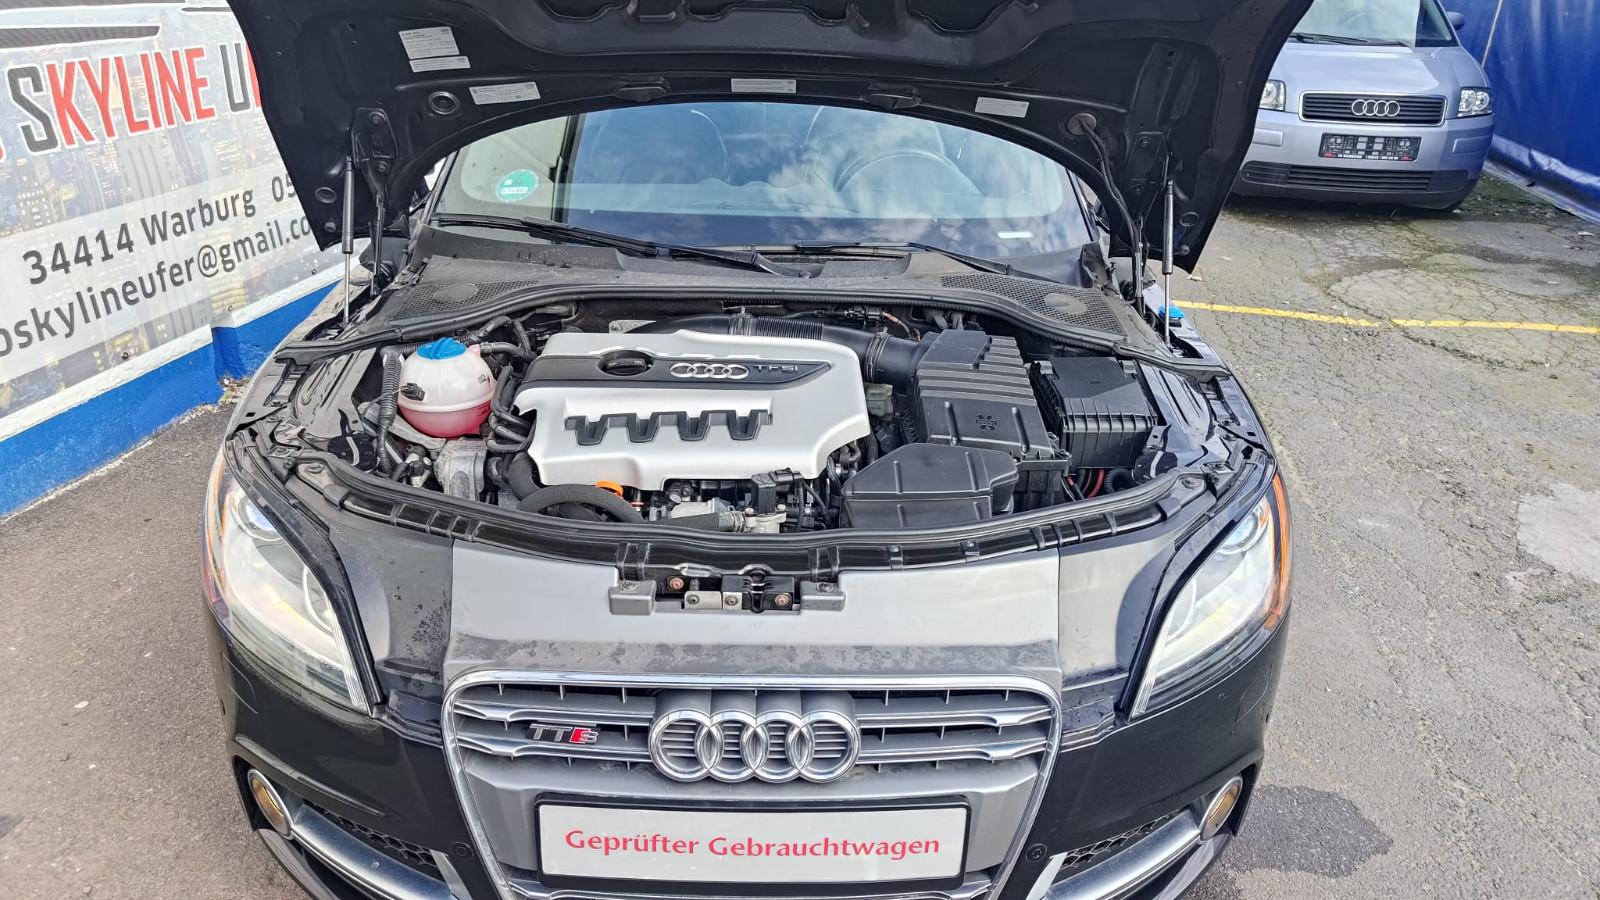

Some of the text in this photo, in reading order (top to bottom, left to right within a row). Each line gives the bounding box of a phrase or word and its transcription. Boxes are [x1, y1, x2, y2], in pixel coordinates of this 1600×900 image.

[7, 42, 261, 152] SKYLINE U
[22, 222, 134, 285] 34414
[140, 189, 256, 246] Warburg
[529, 723, 599, 744] TTS
[565, 830, 940, 860] Geprüfter Gebrauchtwagen
